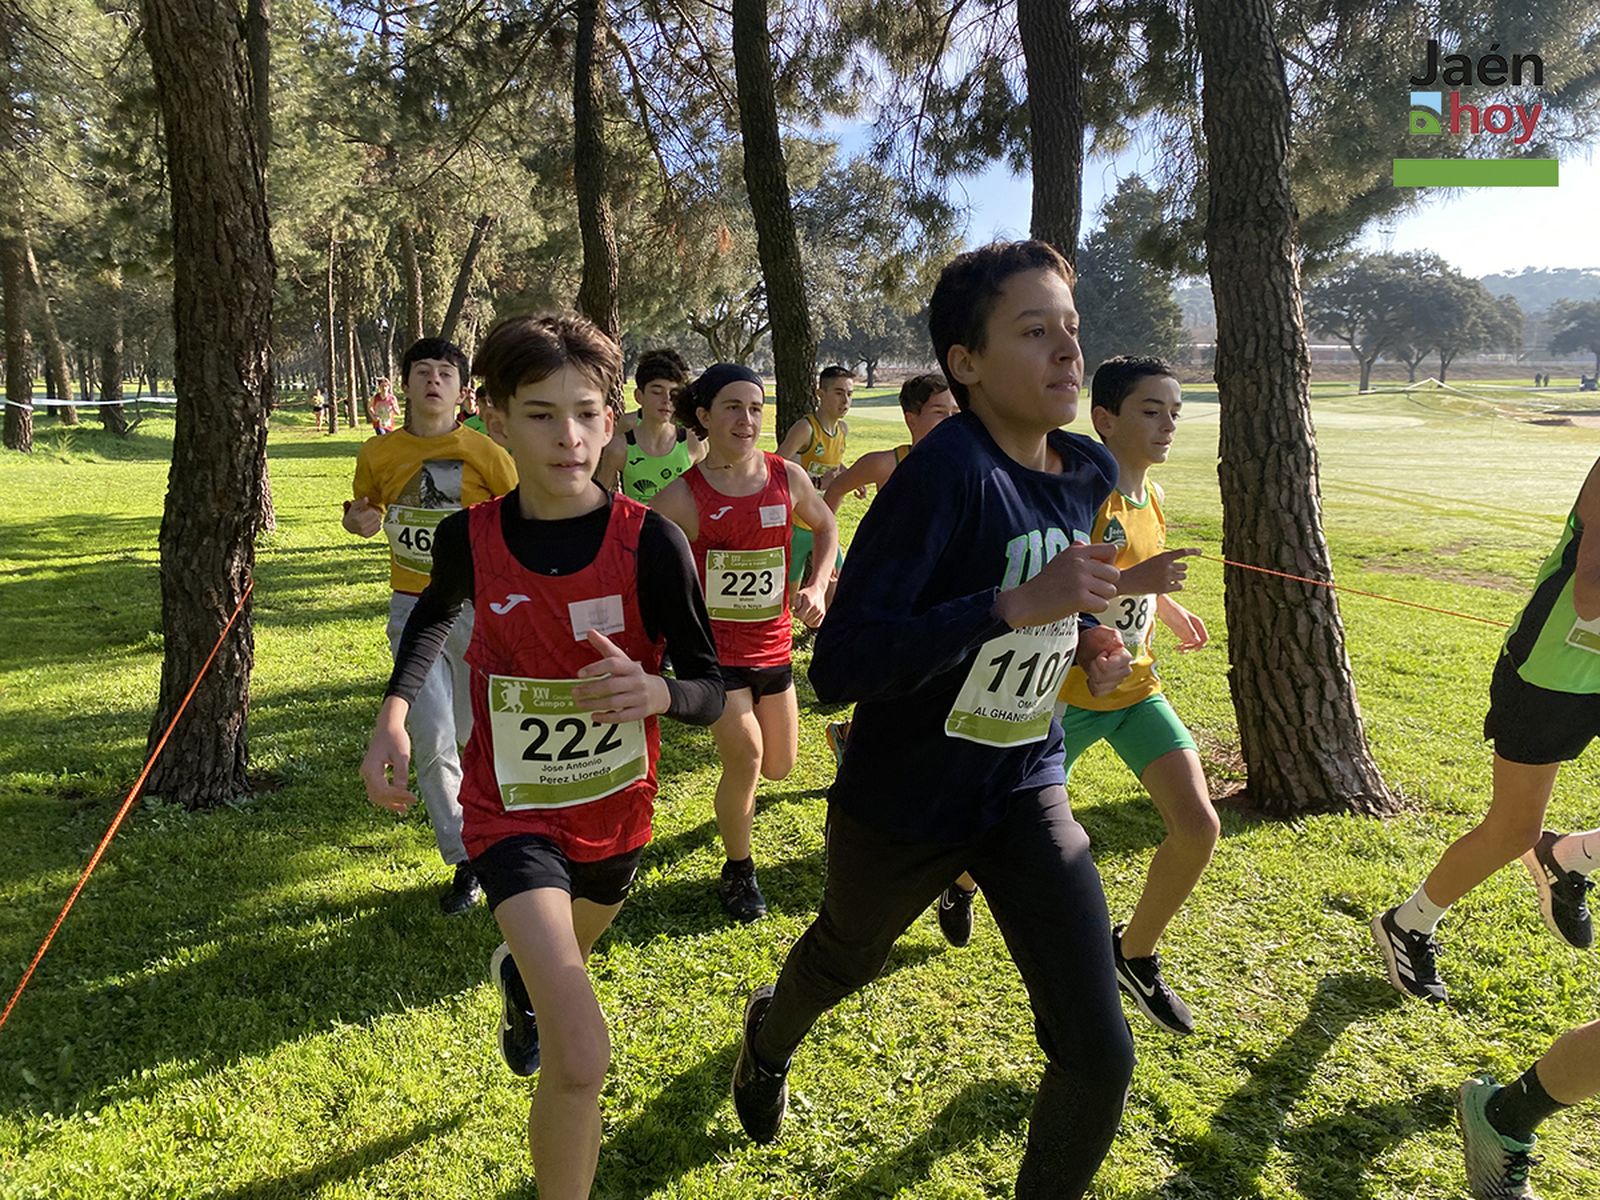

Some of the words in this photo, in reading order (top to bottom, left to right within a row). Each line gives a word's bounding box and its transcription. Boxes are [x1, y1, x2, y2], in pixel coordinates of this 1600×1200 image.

[398, 527, 434, 552] 46
[721, 570, 773, 596] 223
[1115, 598, 1148, 630] 38
[987, 647, 1074, 698] 1107
[532, 686, 550, 700] XXV
[533, 700, 566, 709] Campo
[974, 706, 987, 717] AL
[519, 717, 622, 762] 222
[539, 774, 569, 785] Perez
[572, 766, 611, 782] Lloreda
[541, 764, 564, 773] Jose
[565, 758, 602, 771] Antonio
